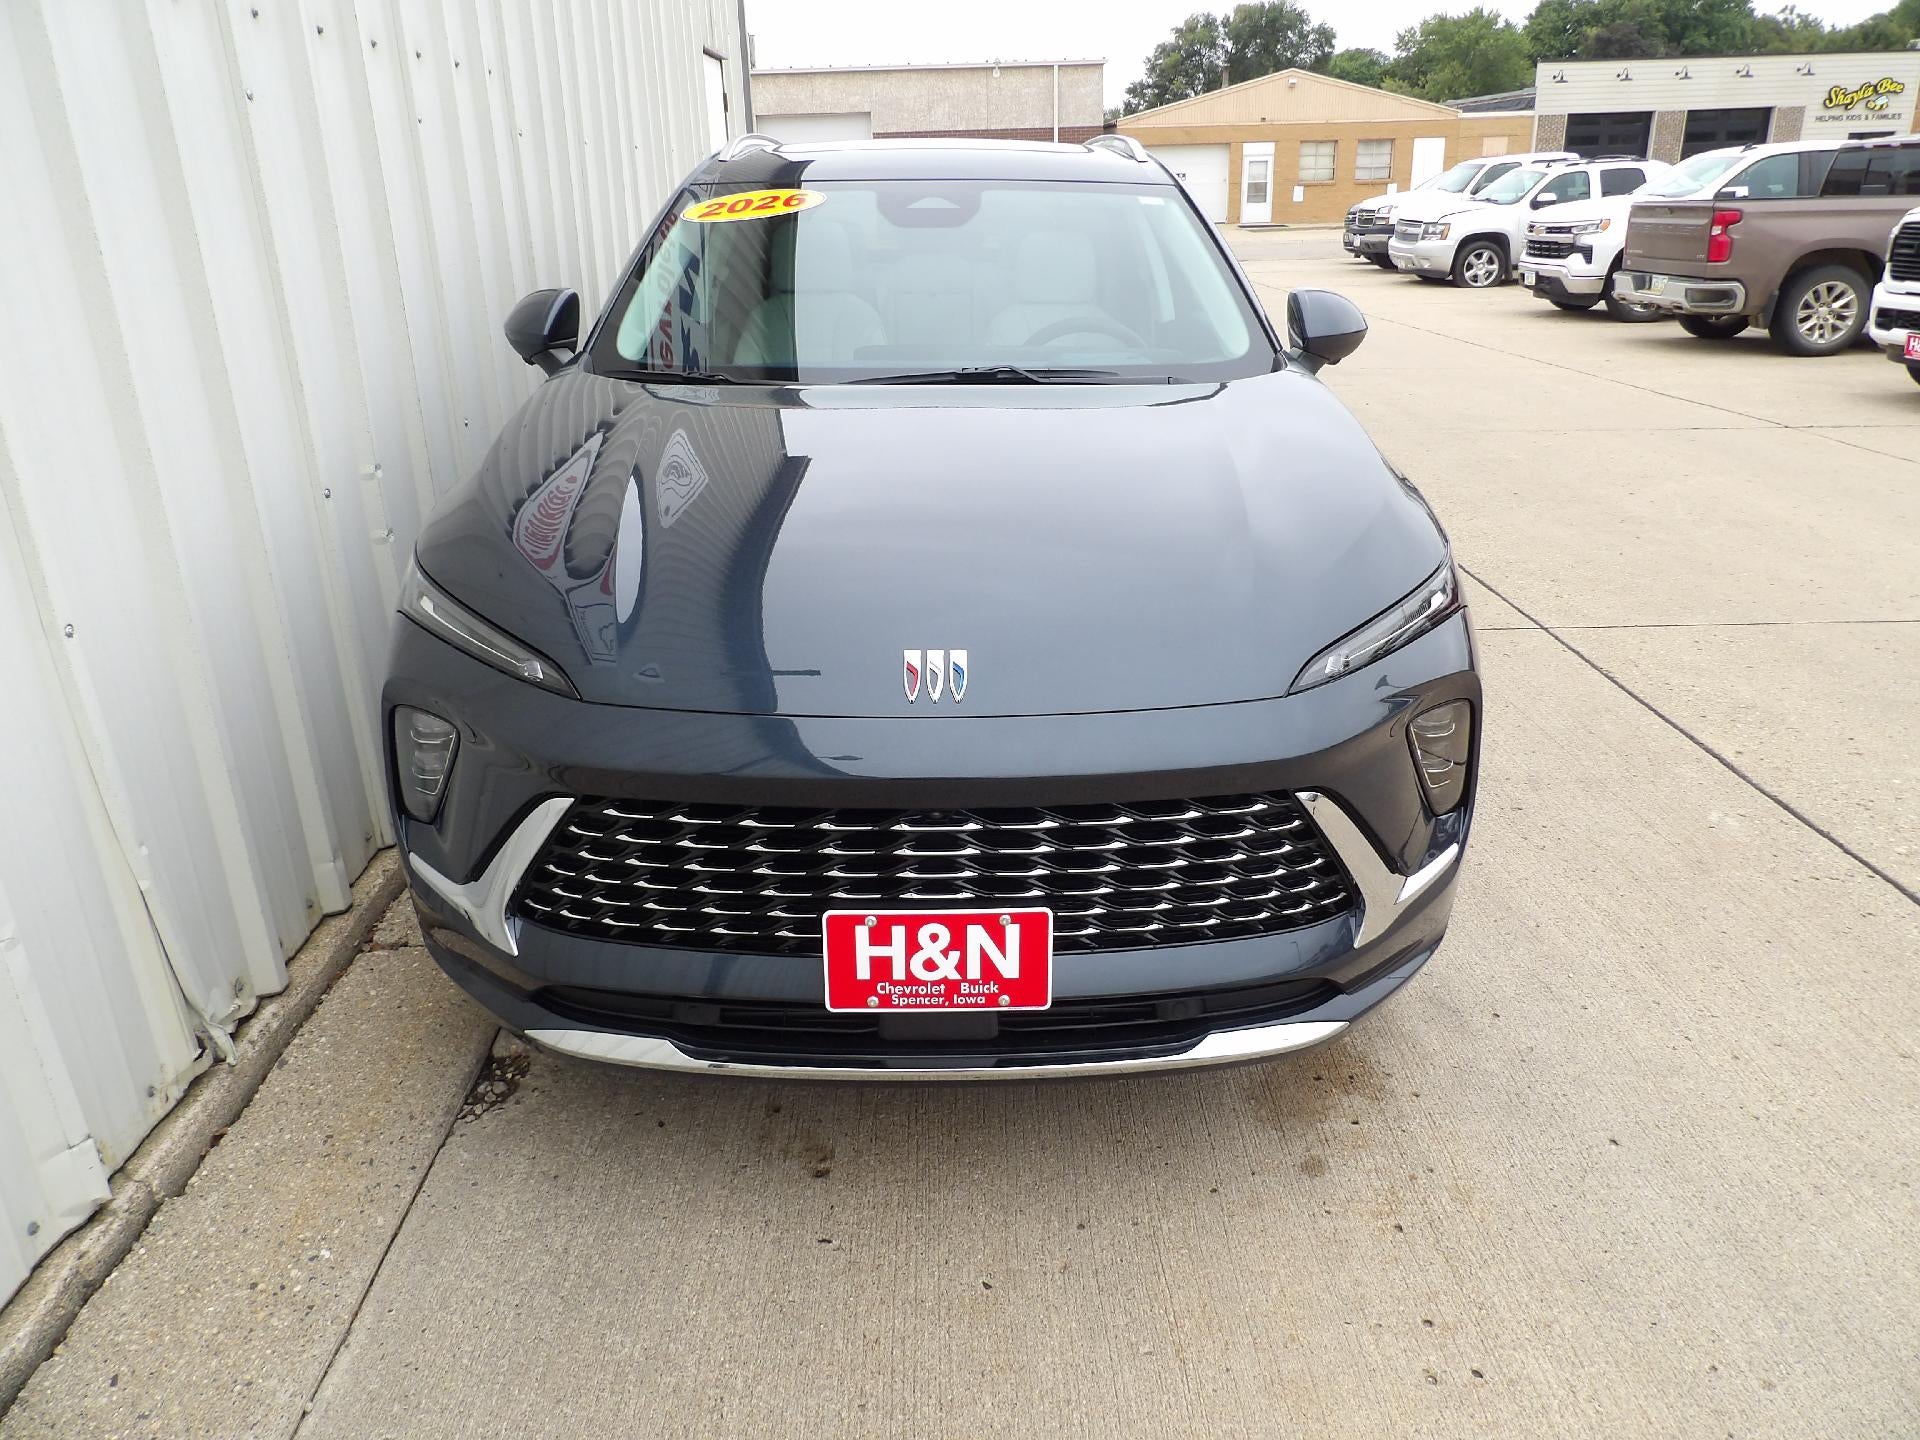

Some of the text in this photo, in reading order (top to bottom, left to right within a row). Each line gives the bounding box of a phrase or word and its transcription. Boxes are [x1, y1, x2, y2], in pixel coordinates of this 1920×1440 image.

[1824, 78, 1904, 110] Shayla Bee
[697, 193, 807, 219] 2026
[854, 922, 1021, 981] H&N
[876, 980, 999, 995] Chevrolet Buick
[891, 993, 986, 1006] Spencer, Iowa
